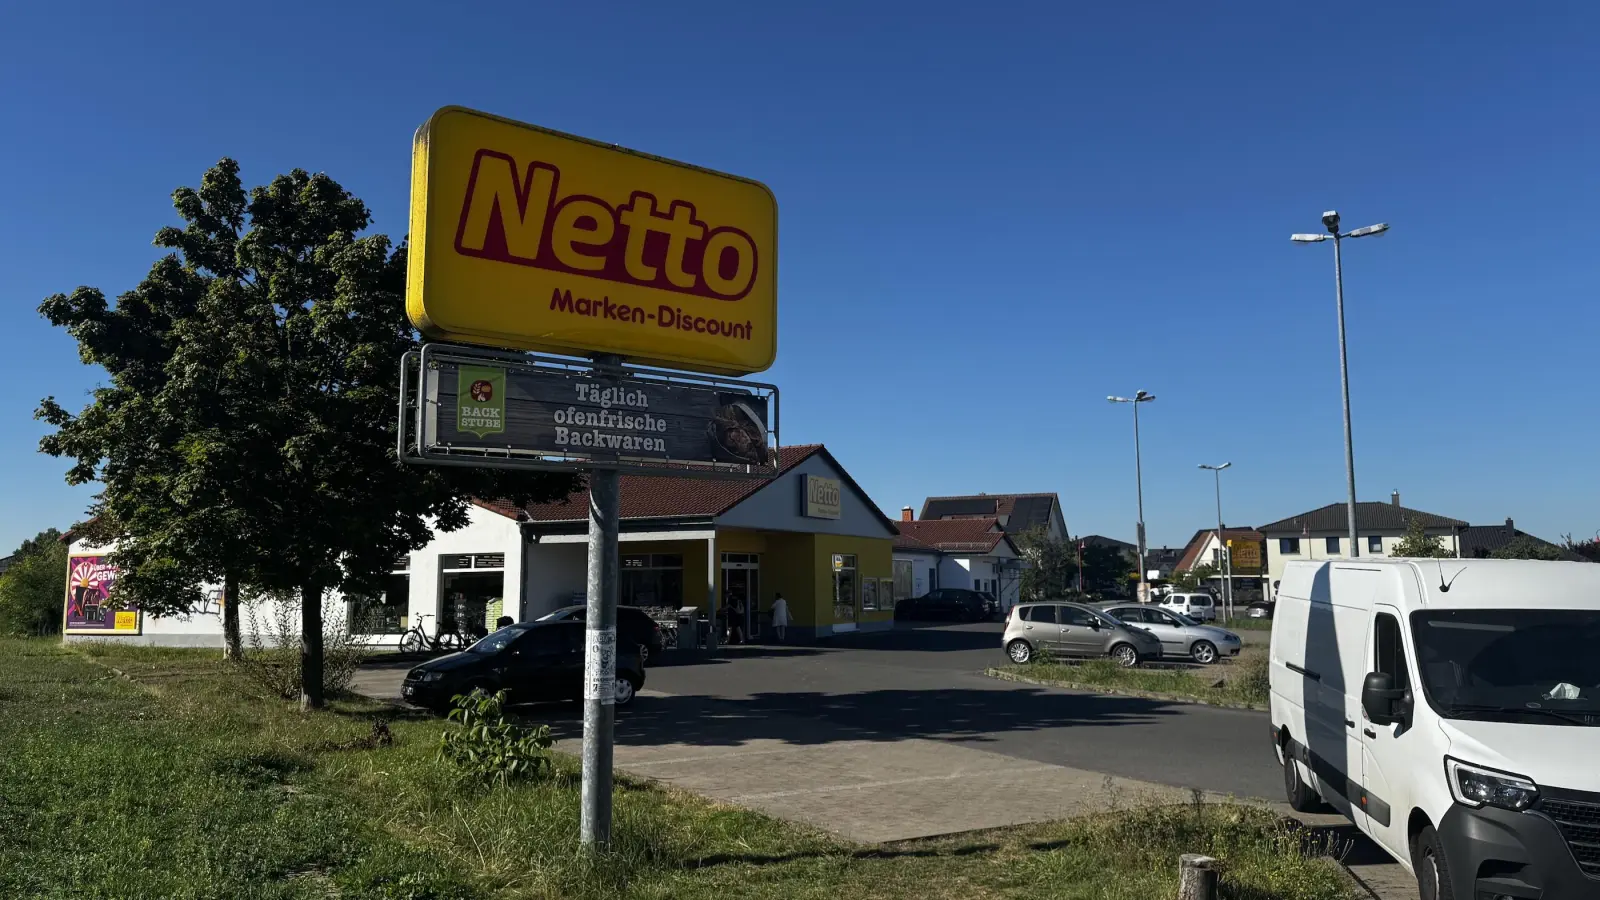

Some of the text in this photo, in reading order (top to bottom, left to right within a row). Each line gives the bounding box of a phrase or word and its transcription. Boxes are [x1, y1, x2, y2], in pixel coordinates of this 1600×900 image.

[454, 148, 758, 301] Netto
[550, 288, 752, 340] Marken-Discount
[575, 383, 648, 408] Täglich
[461, 406, 500, 418] BACK
[461, 418, 501, 429] STUBE
[554, 408, 667, 432] ofenfrische
[555, 427, 666, 451] Backwaren
[809, 478, 839, 507] Netto
